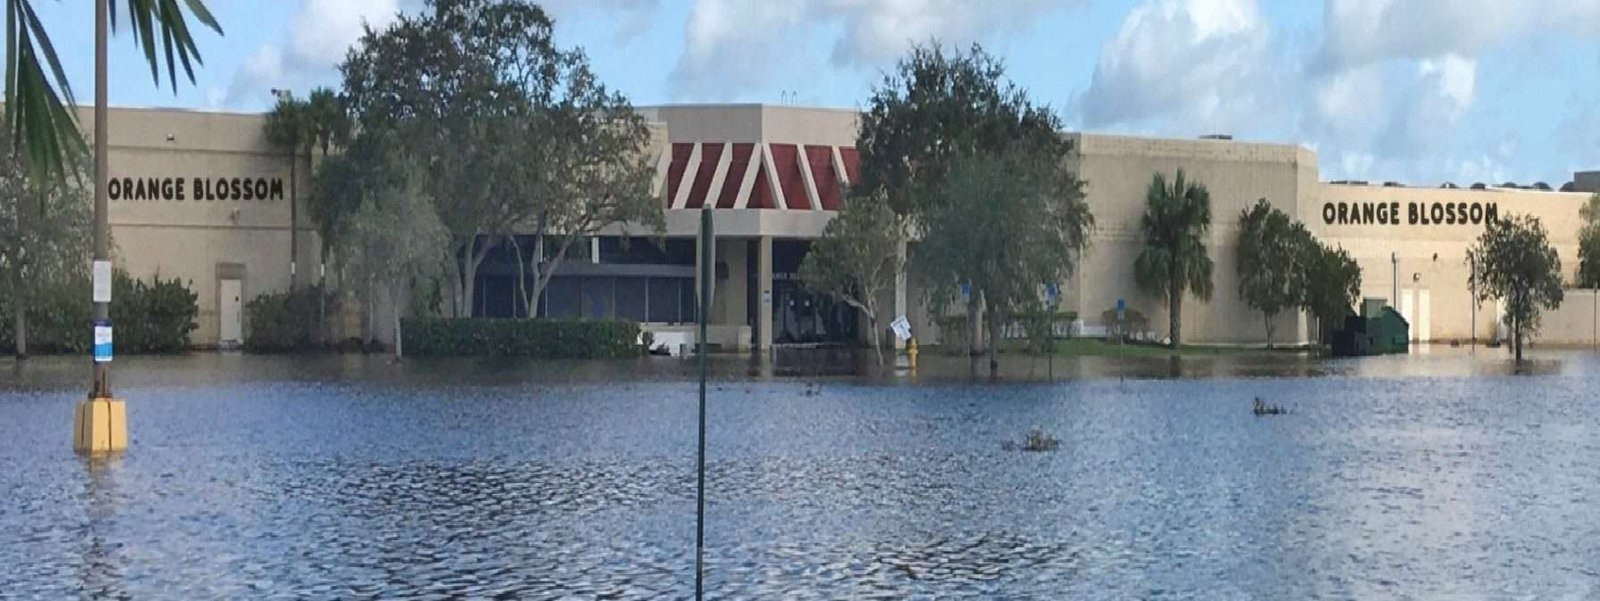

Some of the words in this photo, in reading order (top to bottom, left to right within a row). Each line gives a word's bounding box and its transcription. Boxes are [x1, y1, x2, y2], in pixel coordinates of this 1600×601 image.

[108, 177, 185, 200] ORANGE
[193, 177, 284, 200] BLOSSOM
[1322, 202, 1400, 225] ORANGE
[1408, 202, 1499, 225] BLOSSOM
